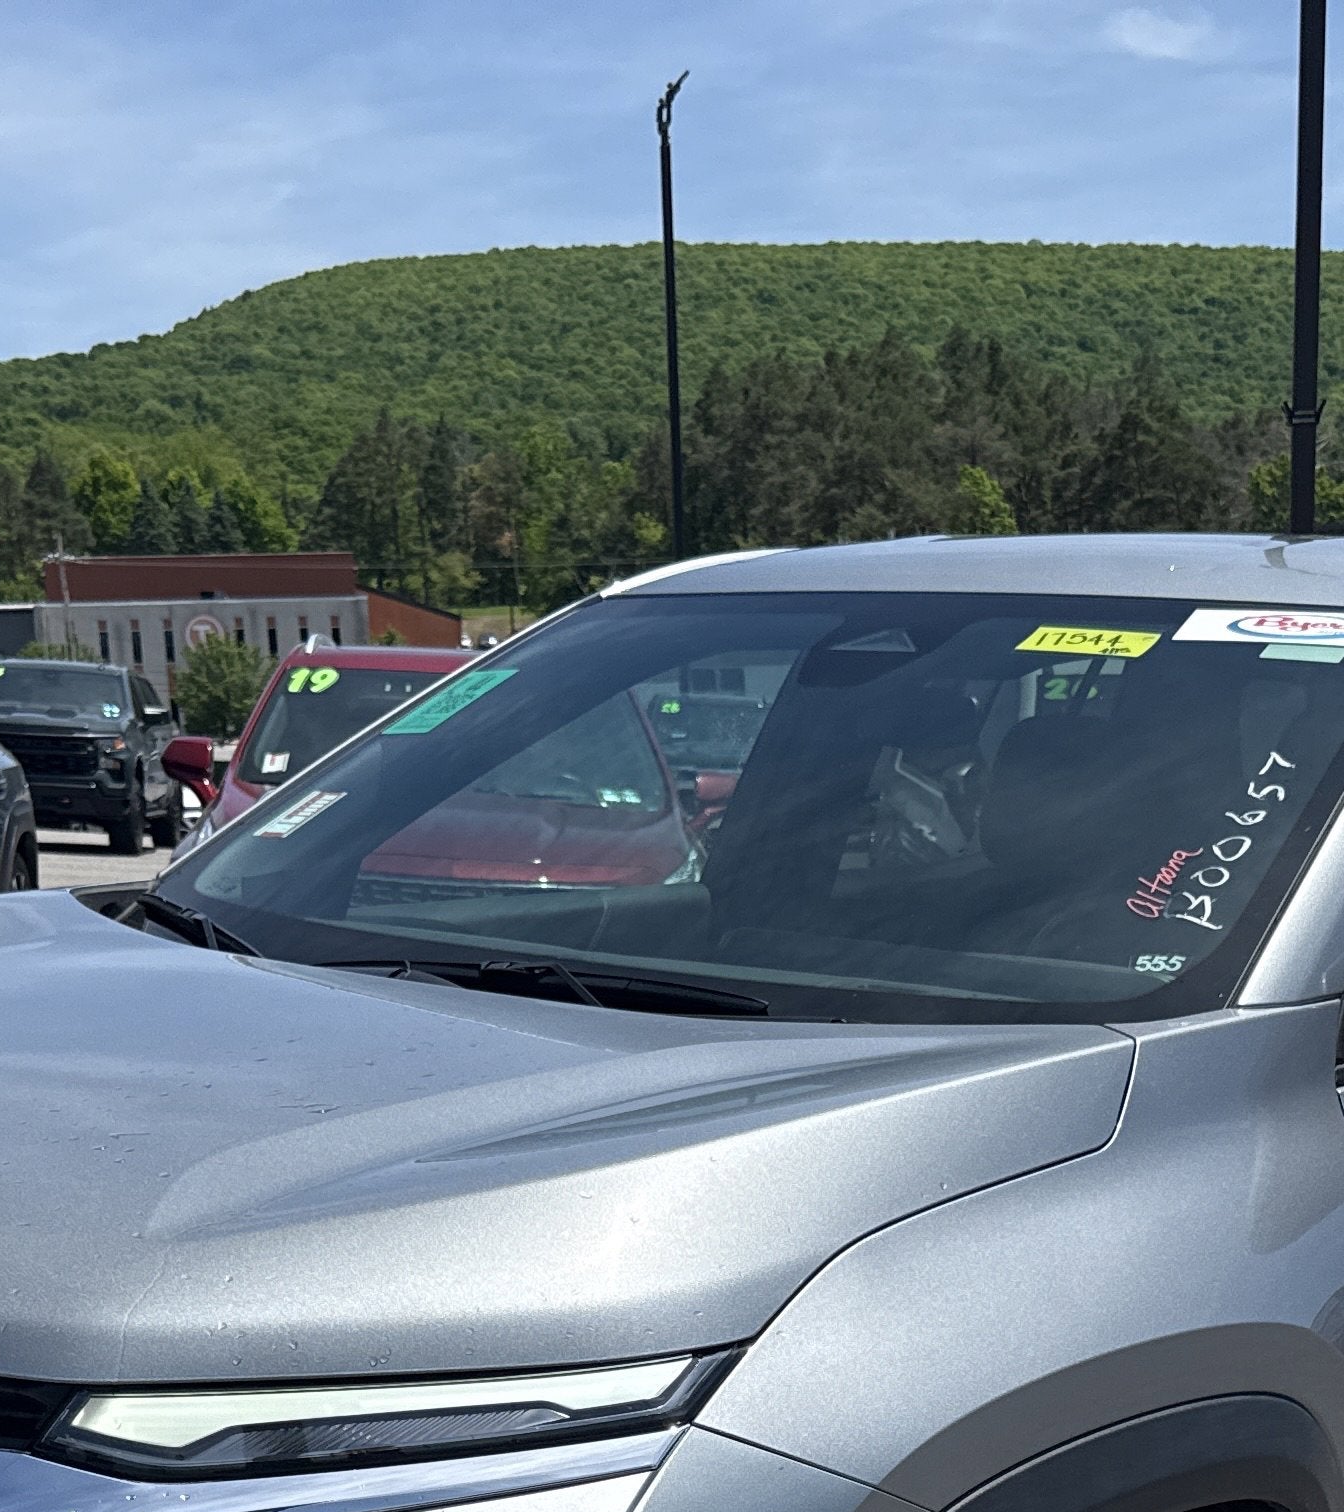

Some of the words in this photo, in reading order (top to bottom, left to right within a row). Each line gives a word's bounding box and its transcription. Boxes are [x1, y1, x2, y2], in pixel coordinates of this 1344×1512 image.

[1036, 632, 1125, 647] 17544
[288, 668, 340, 693] 19
[1134, 955, 1186, 971] 555
